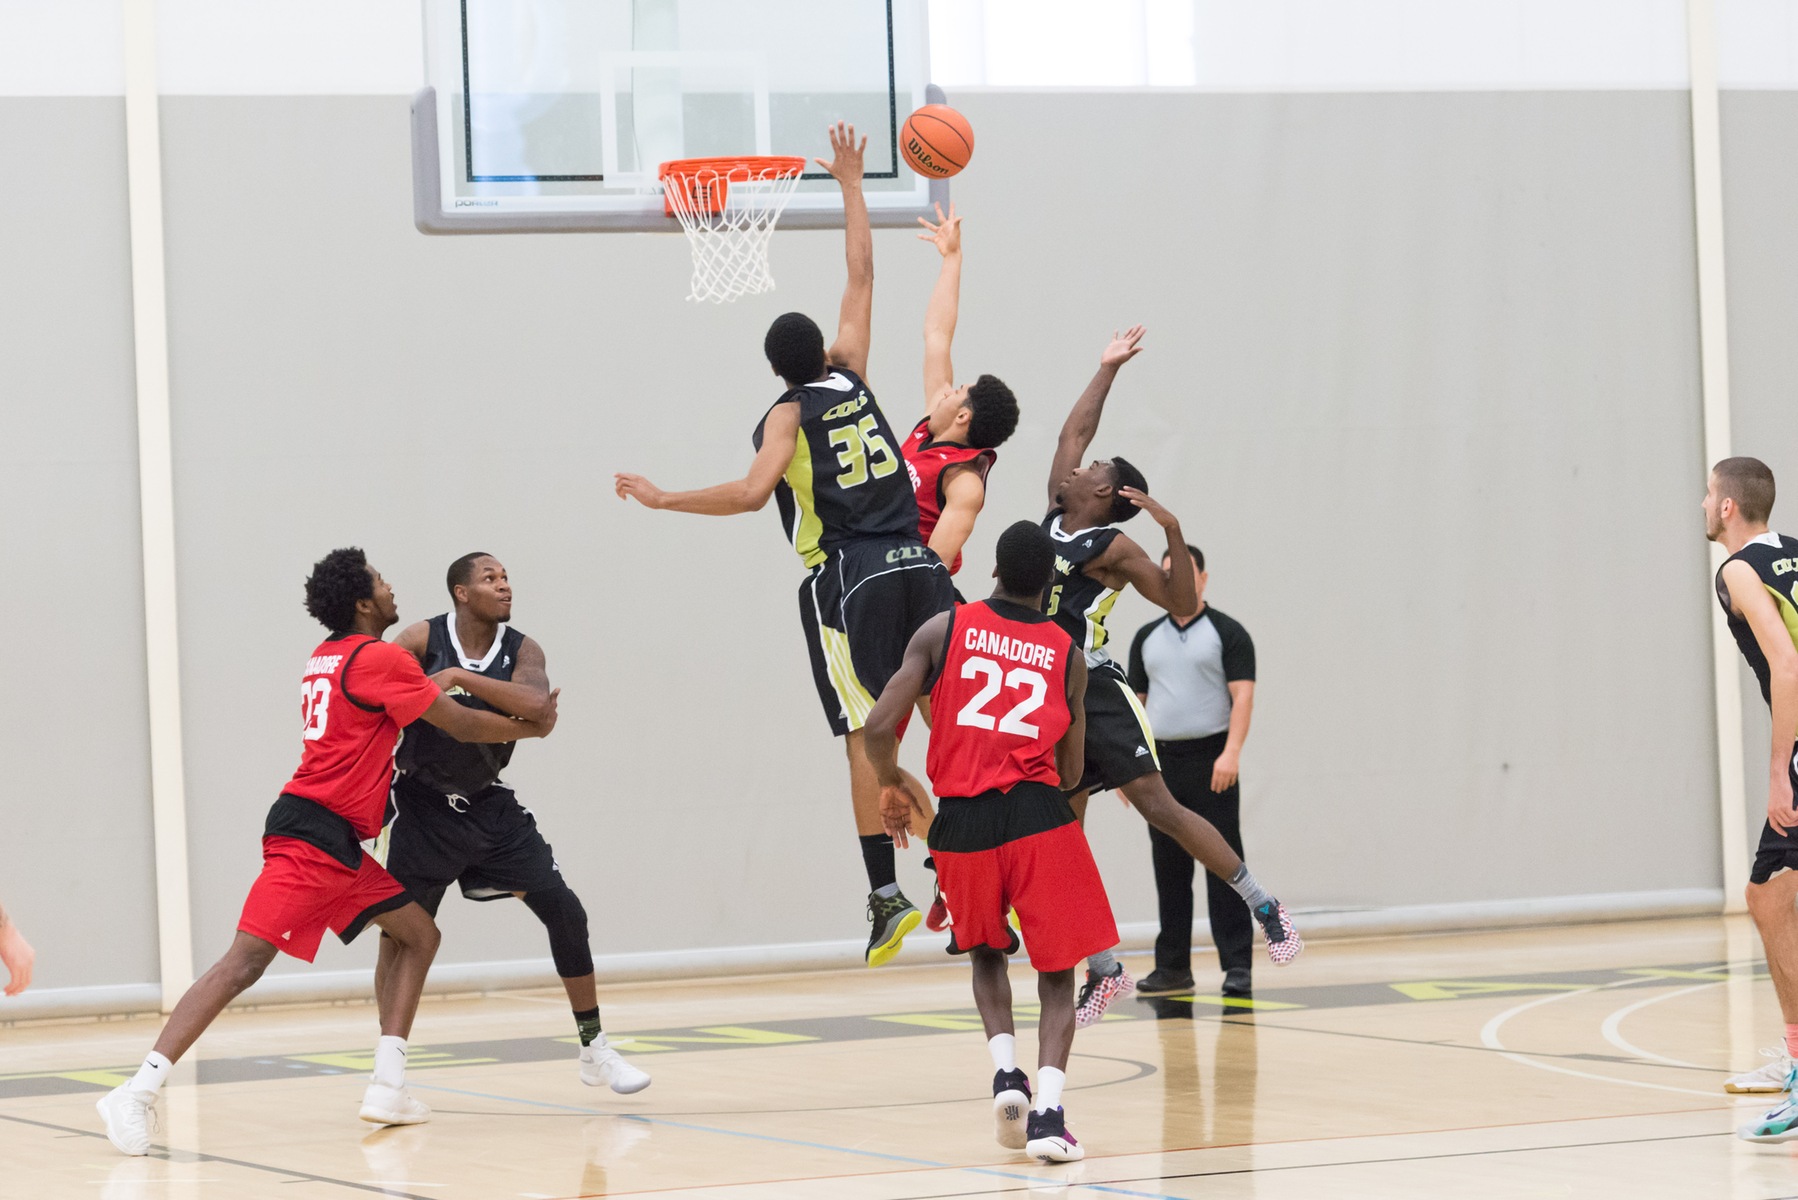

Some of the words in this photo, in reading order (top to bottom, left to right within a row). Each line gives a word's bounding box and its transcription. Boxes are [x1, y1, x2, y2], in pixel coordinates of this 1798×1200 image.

[908, 138, 949, 174] Wilson
[828, 413, 898, 489] 35
[965, 627, 1055, 670] CANADORE
[956, 655, 1048, 739] 22
